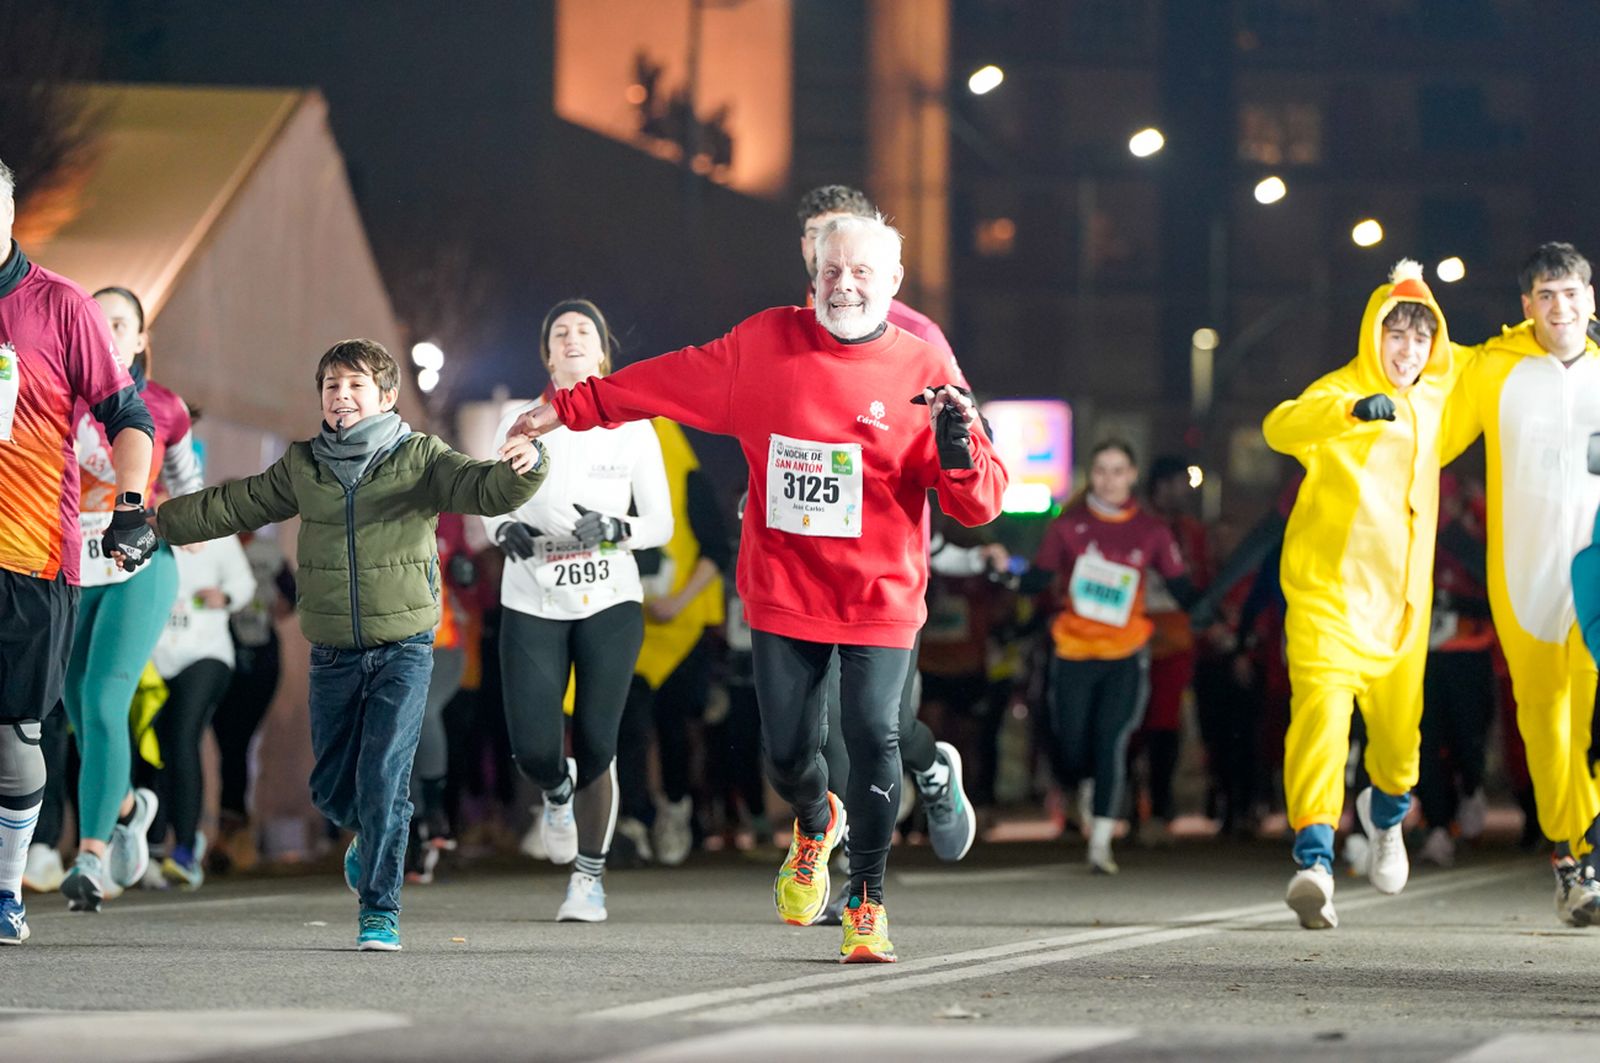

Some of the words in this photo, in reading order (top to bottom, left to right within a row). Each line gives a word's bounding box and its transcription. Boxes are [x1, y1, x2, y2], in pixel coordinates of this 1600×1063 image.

[784, 448, 809, 461] NOCHE
[811, 452, 823, 461] DE
[775, 458, 791, 469] SAN
[793, 461, 823, 473] ANTÓN
[784, 472, 839, 504] 3125
[805, 504, 825, 513] Carlos
[547, 552, 563, 562] SAN
[554, 559, 610, 587] 2693
